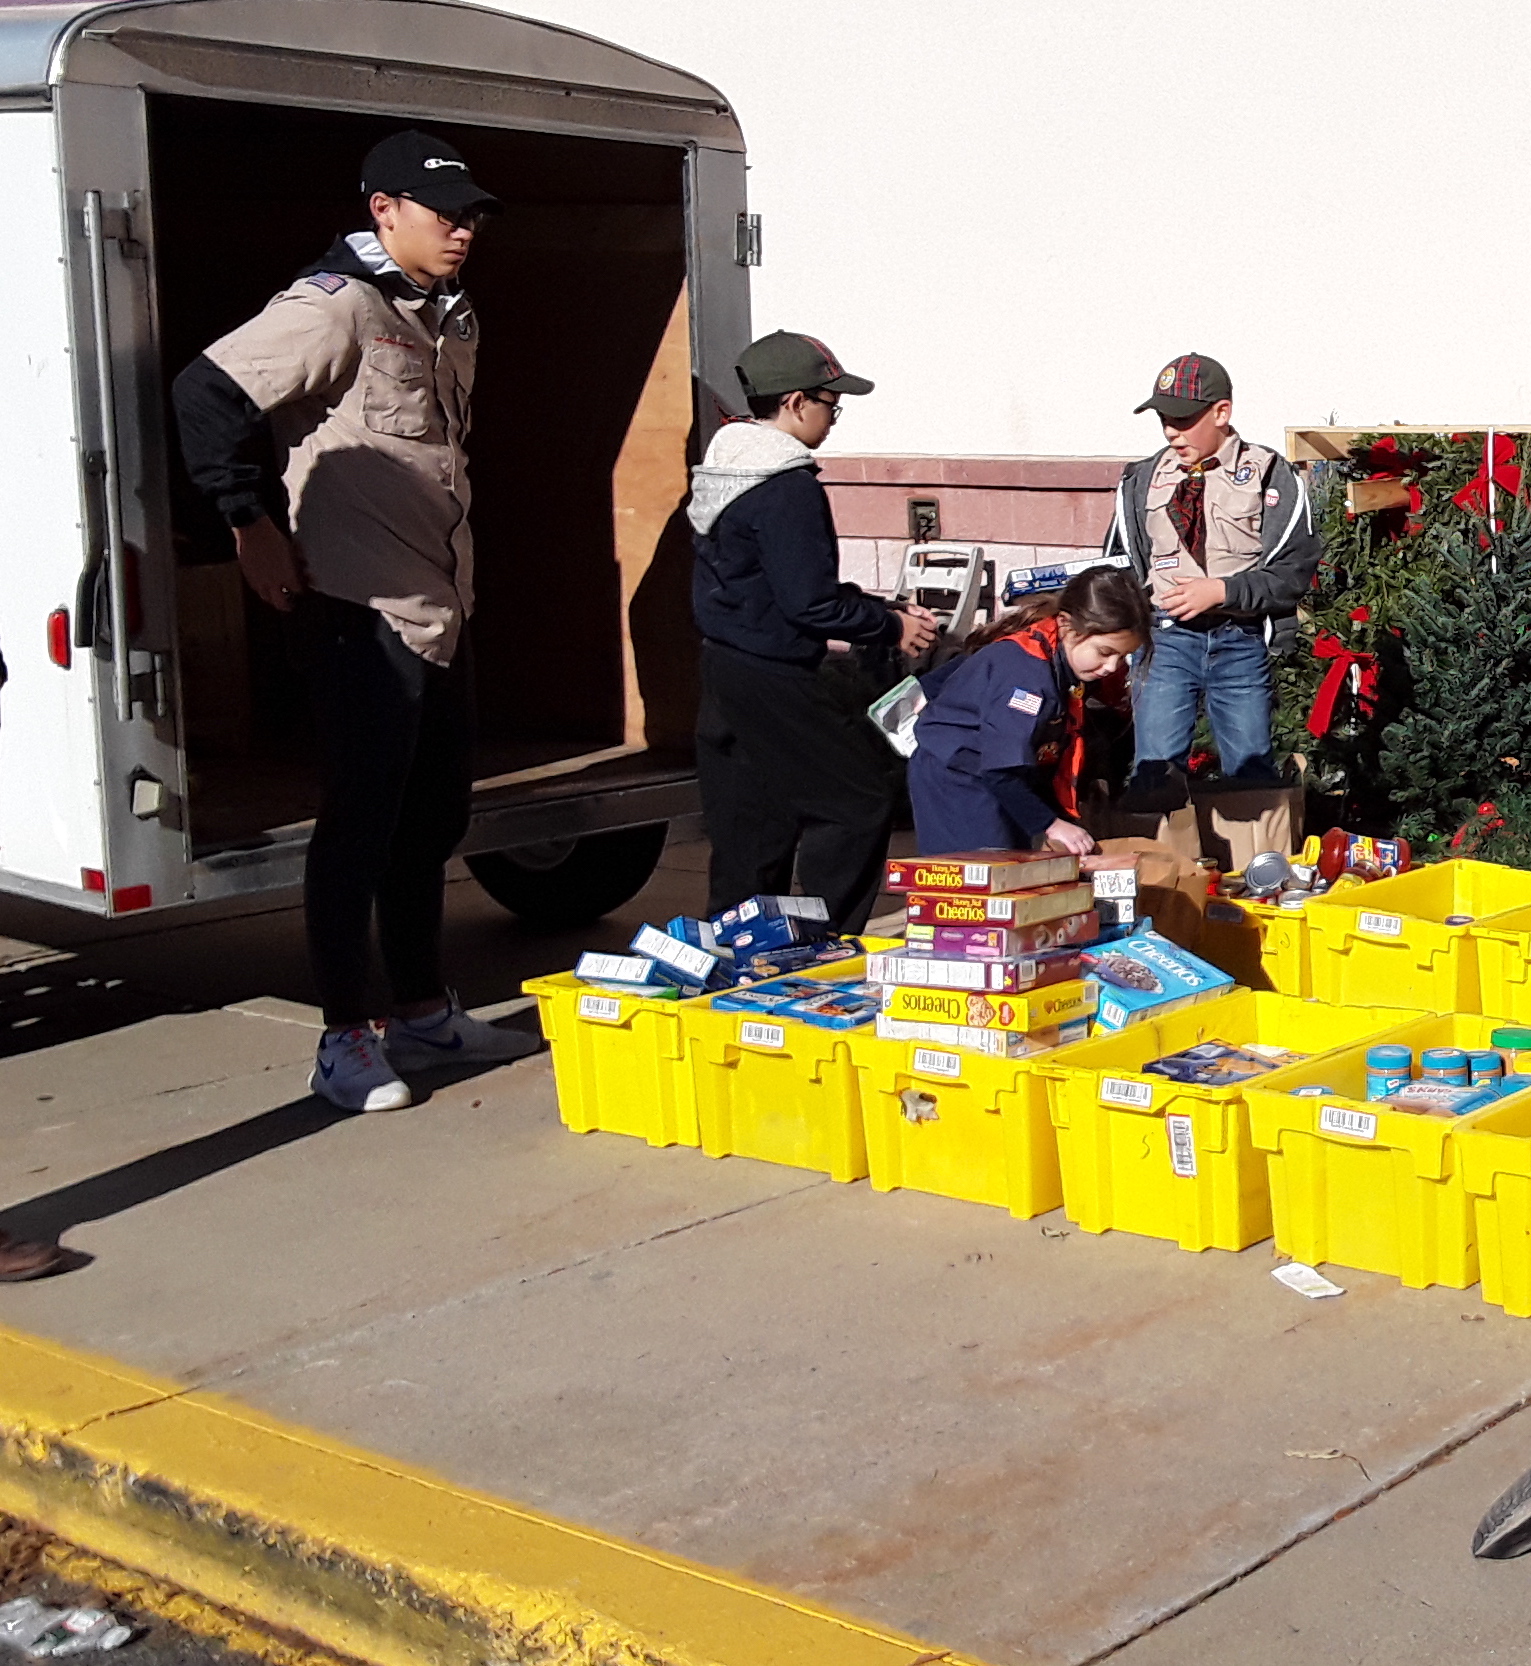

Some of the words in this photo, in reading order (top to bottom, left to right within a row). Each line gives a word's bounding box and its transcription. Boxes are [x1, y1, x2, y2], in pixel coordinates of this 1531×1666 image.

[915, 868, 963, 887] Cheerios
[935, 902, 985, 921] Cheerios
[1128, 940, 1204, 986] Cheerios
[902, 993, 960, 1019] Cheerios
